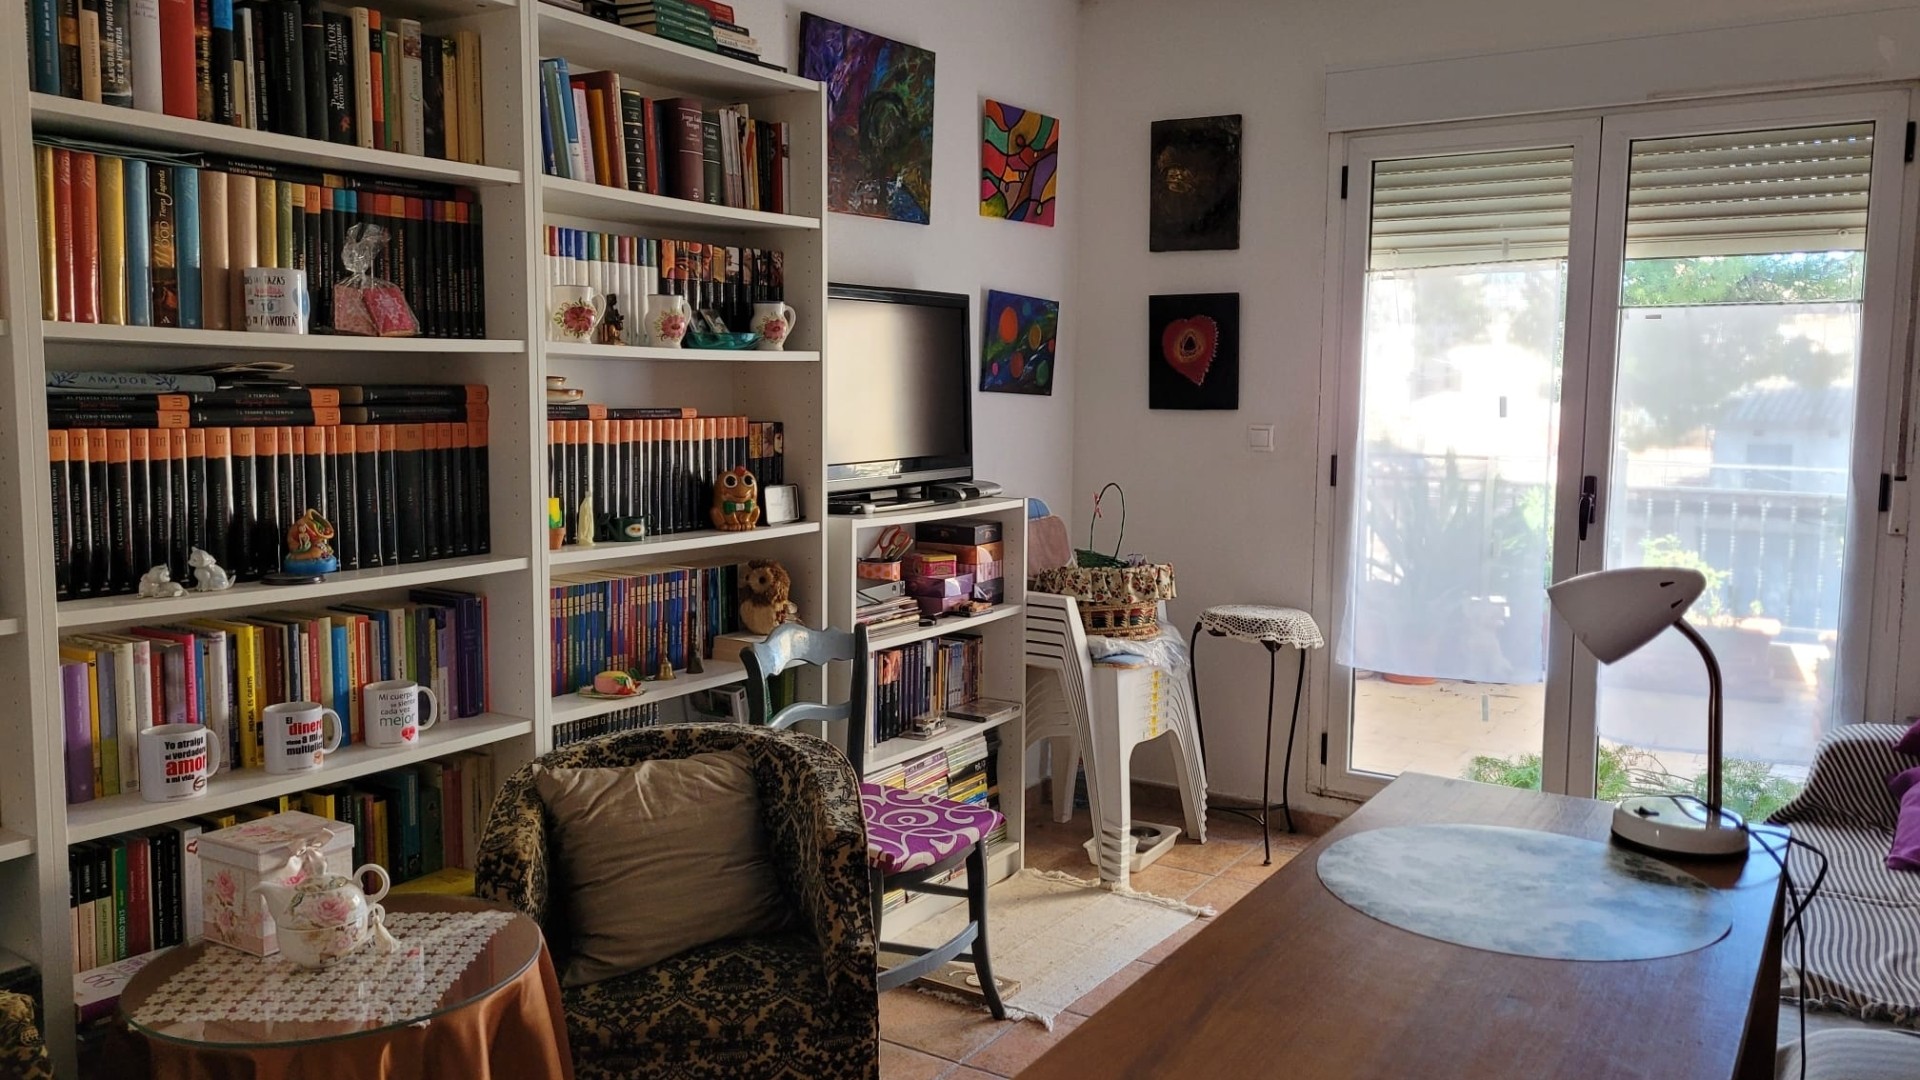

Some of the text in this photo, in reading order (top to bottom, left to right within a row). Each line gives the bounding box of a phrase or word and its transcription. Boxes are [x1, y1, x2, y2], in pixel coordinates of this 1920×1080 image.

[107, 33, 116, 67] GRANDES
[327, 23, 338, 62] TEMOR
[116, 27, 124, 84] DE LA HISTORIA
[108, 68, 116, 83] LAS
[330, 76, 339, 106] PATRICK
[88, 374, 148, 385] AMADOR
[378, 693, 389, 701] Mi
[285, 716, 293, 724] El
[379, 713, 415, 728] mejor
[164, 741, 176, 750] Yo
[302, 736, 308, 744] a
[309, 733, 318, 743] mi
[166, 755, 206, 776] amor
[181, 774, 195, 782] vida
